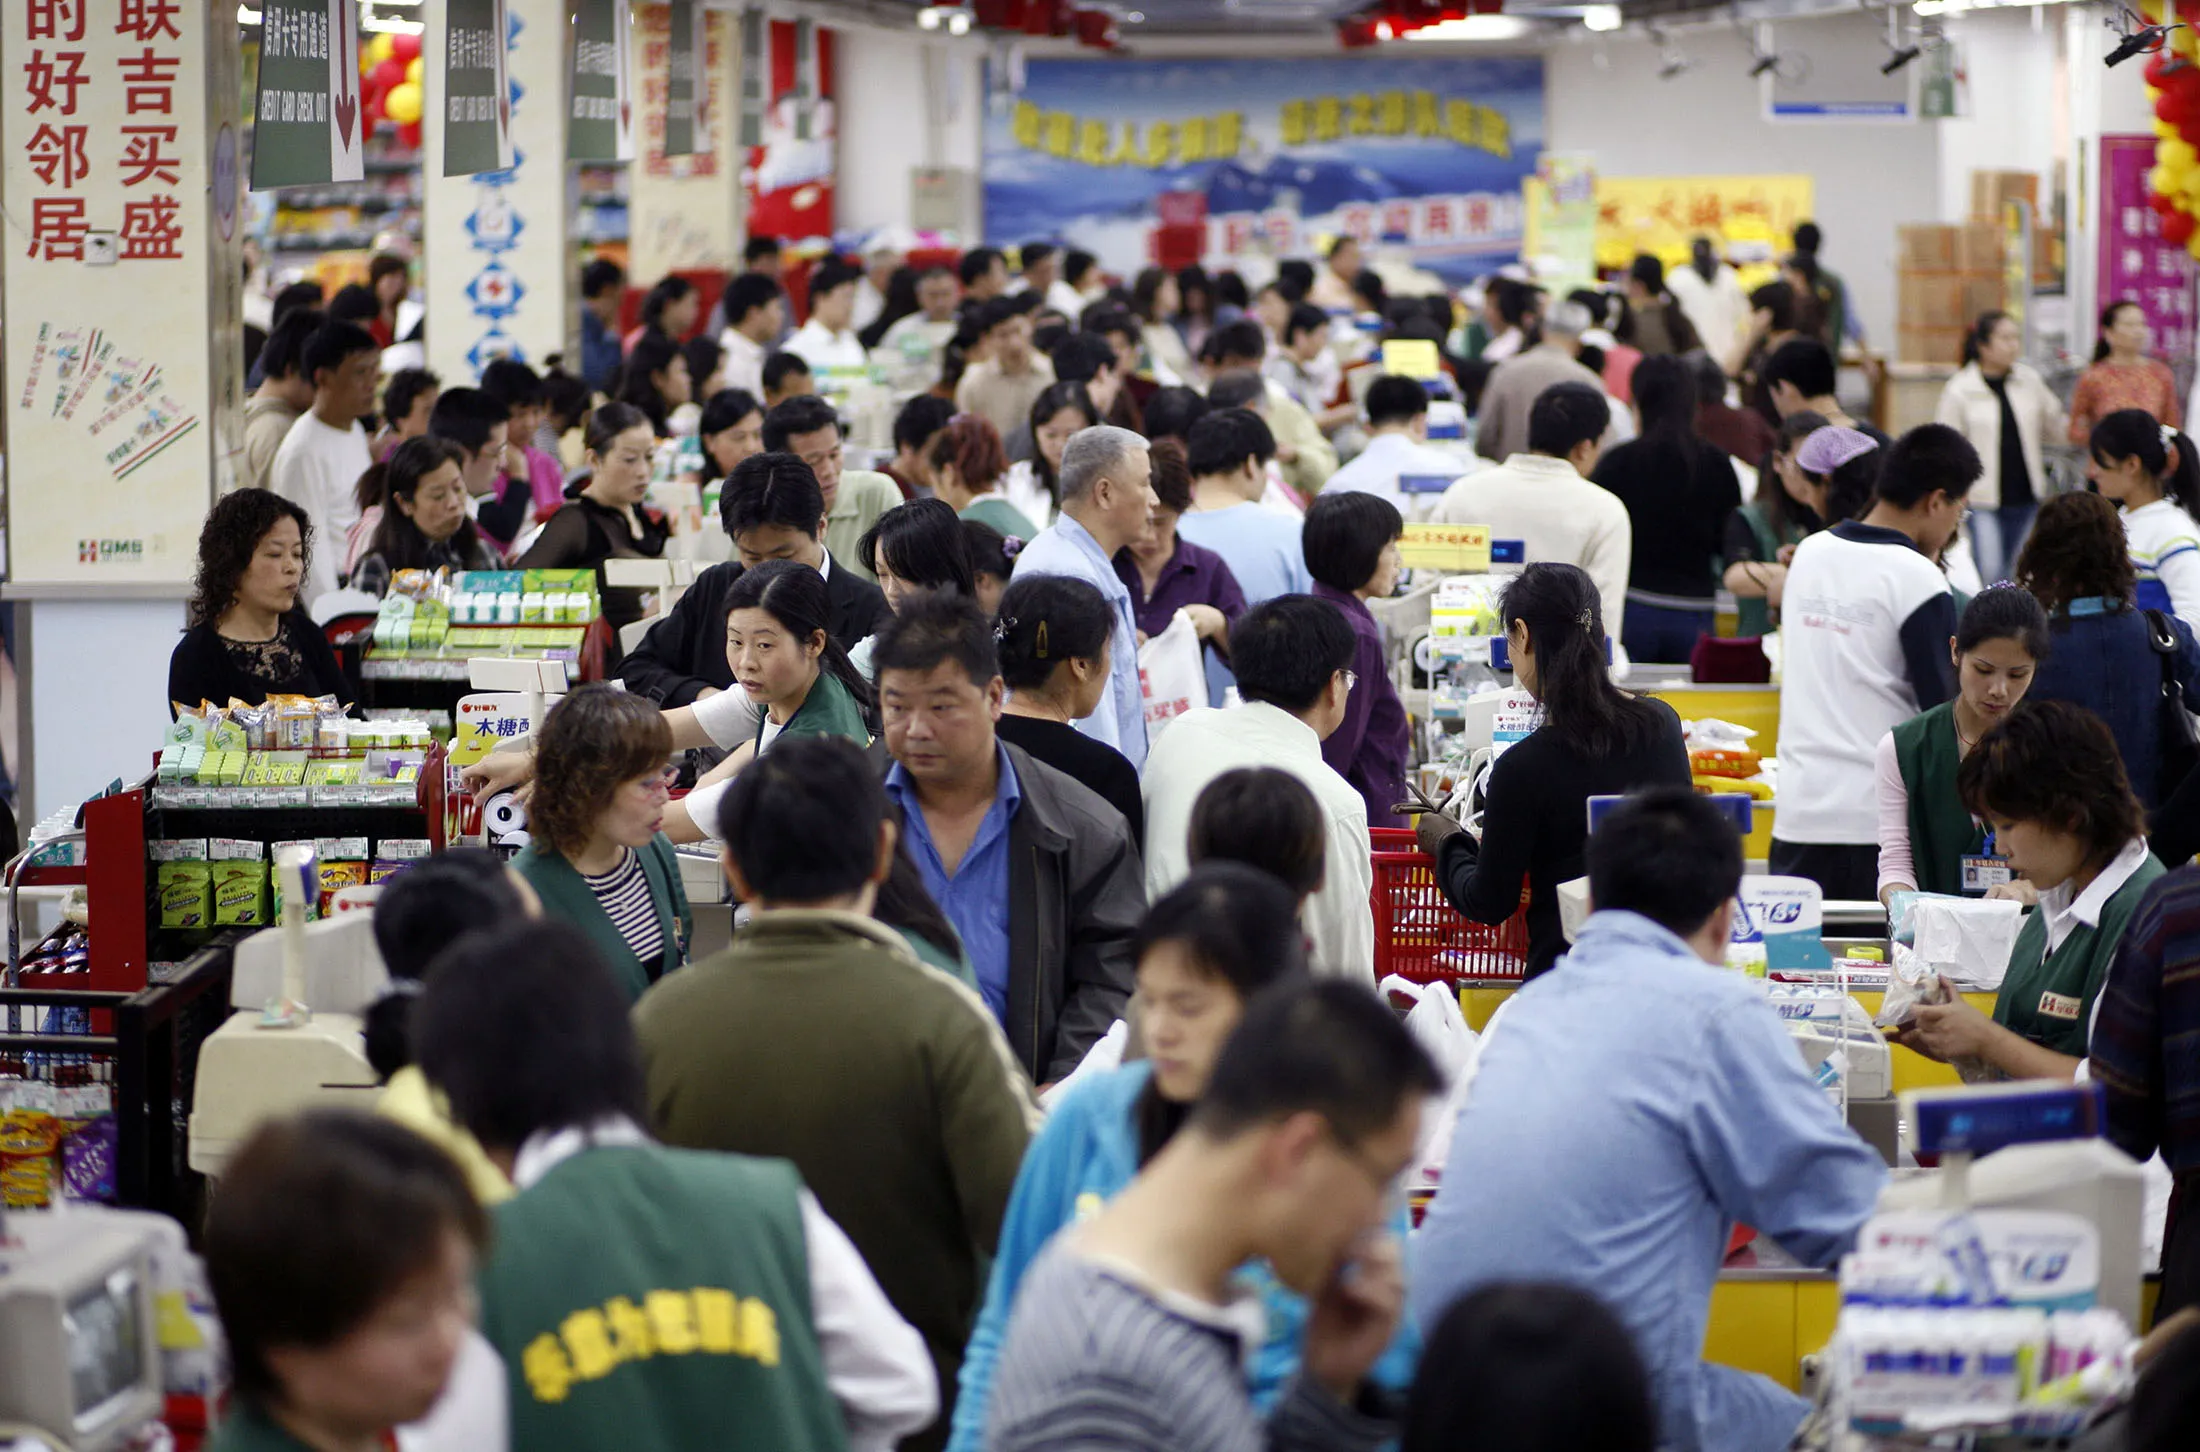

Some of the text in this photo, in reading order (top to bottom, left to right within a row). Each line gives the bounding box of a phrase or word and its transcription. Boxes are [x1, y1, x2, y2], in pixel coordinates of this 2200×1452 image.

[24, 0, 91, 262] 的好邻居
[115, 0, 183, 260] 联吉买盛
[261, 89, 327, 122] CREDIT CARD CHECK OUT
